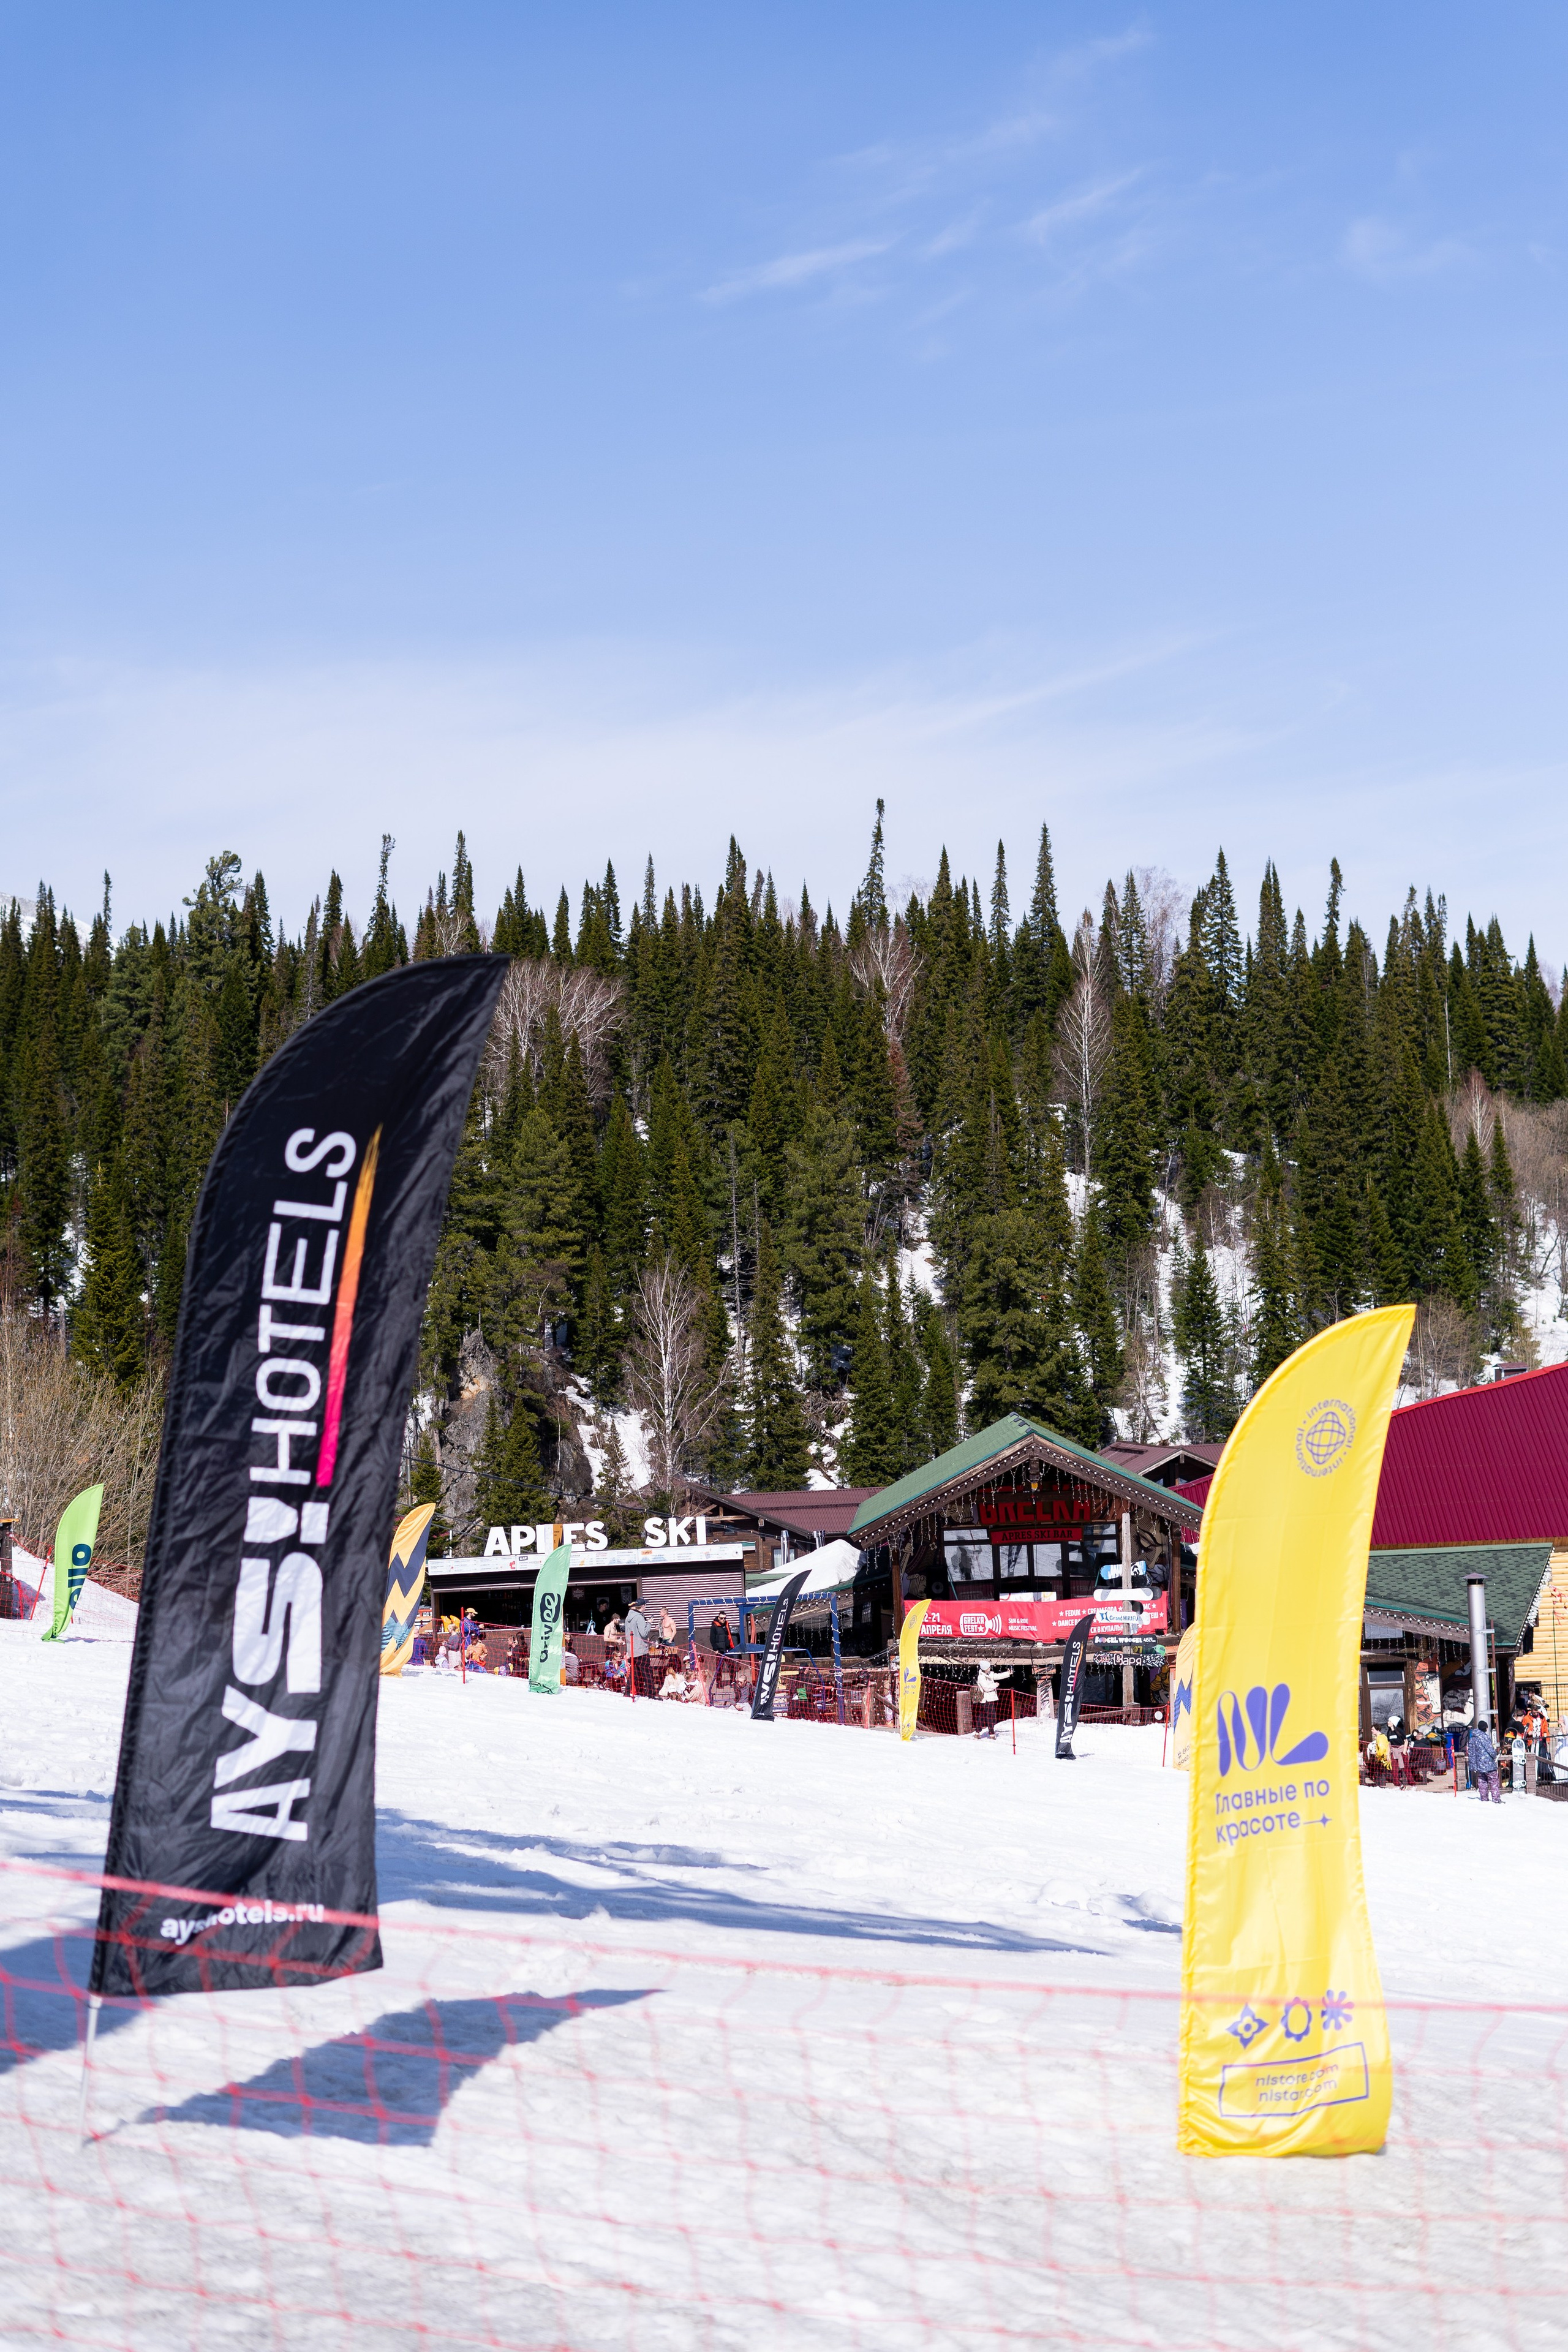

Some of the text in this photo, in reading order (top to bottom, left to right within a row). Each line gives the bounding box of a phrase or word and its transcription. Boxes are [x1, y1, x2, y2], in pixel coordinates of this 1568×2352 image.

[1306, 1399, 1356, 1448] international
[483, 1516, 707, 1556] APES SKI
[1001, 1529, 1073, 1542] APRES SKI BAR
[922, 1612, 940, 1623] 2-21
[963, 1616, 984, 1624] GRELKA
[921, 1624, 952, 1635] АПРЕЛЯ
[1216, 1779, 1330, 1815] Главные по
[1216, 1811, 1300, 1846] красоте
[1256, 2063, 1339, 2087] nlstore.com
[1259, 2079, 1337, 2102] nlstar.com
